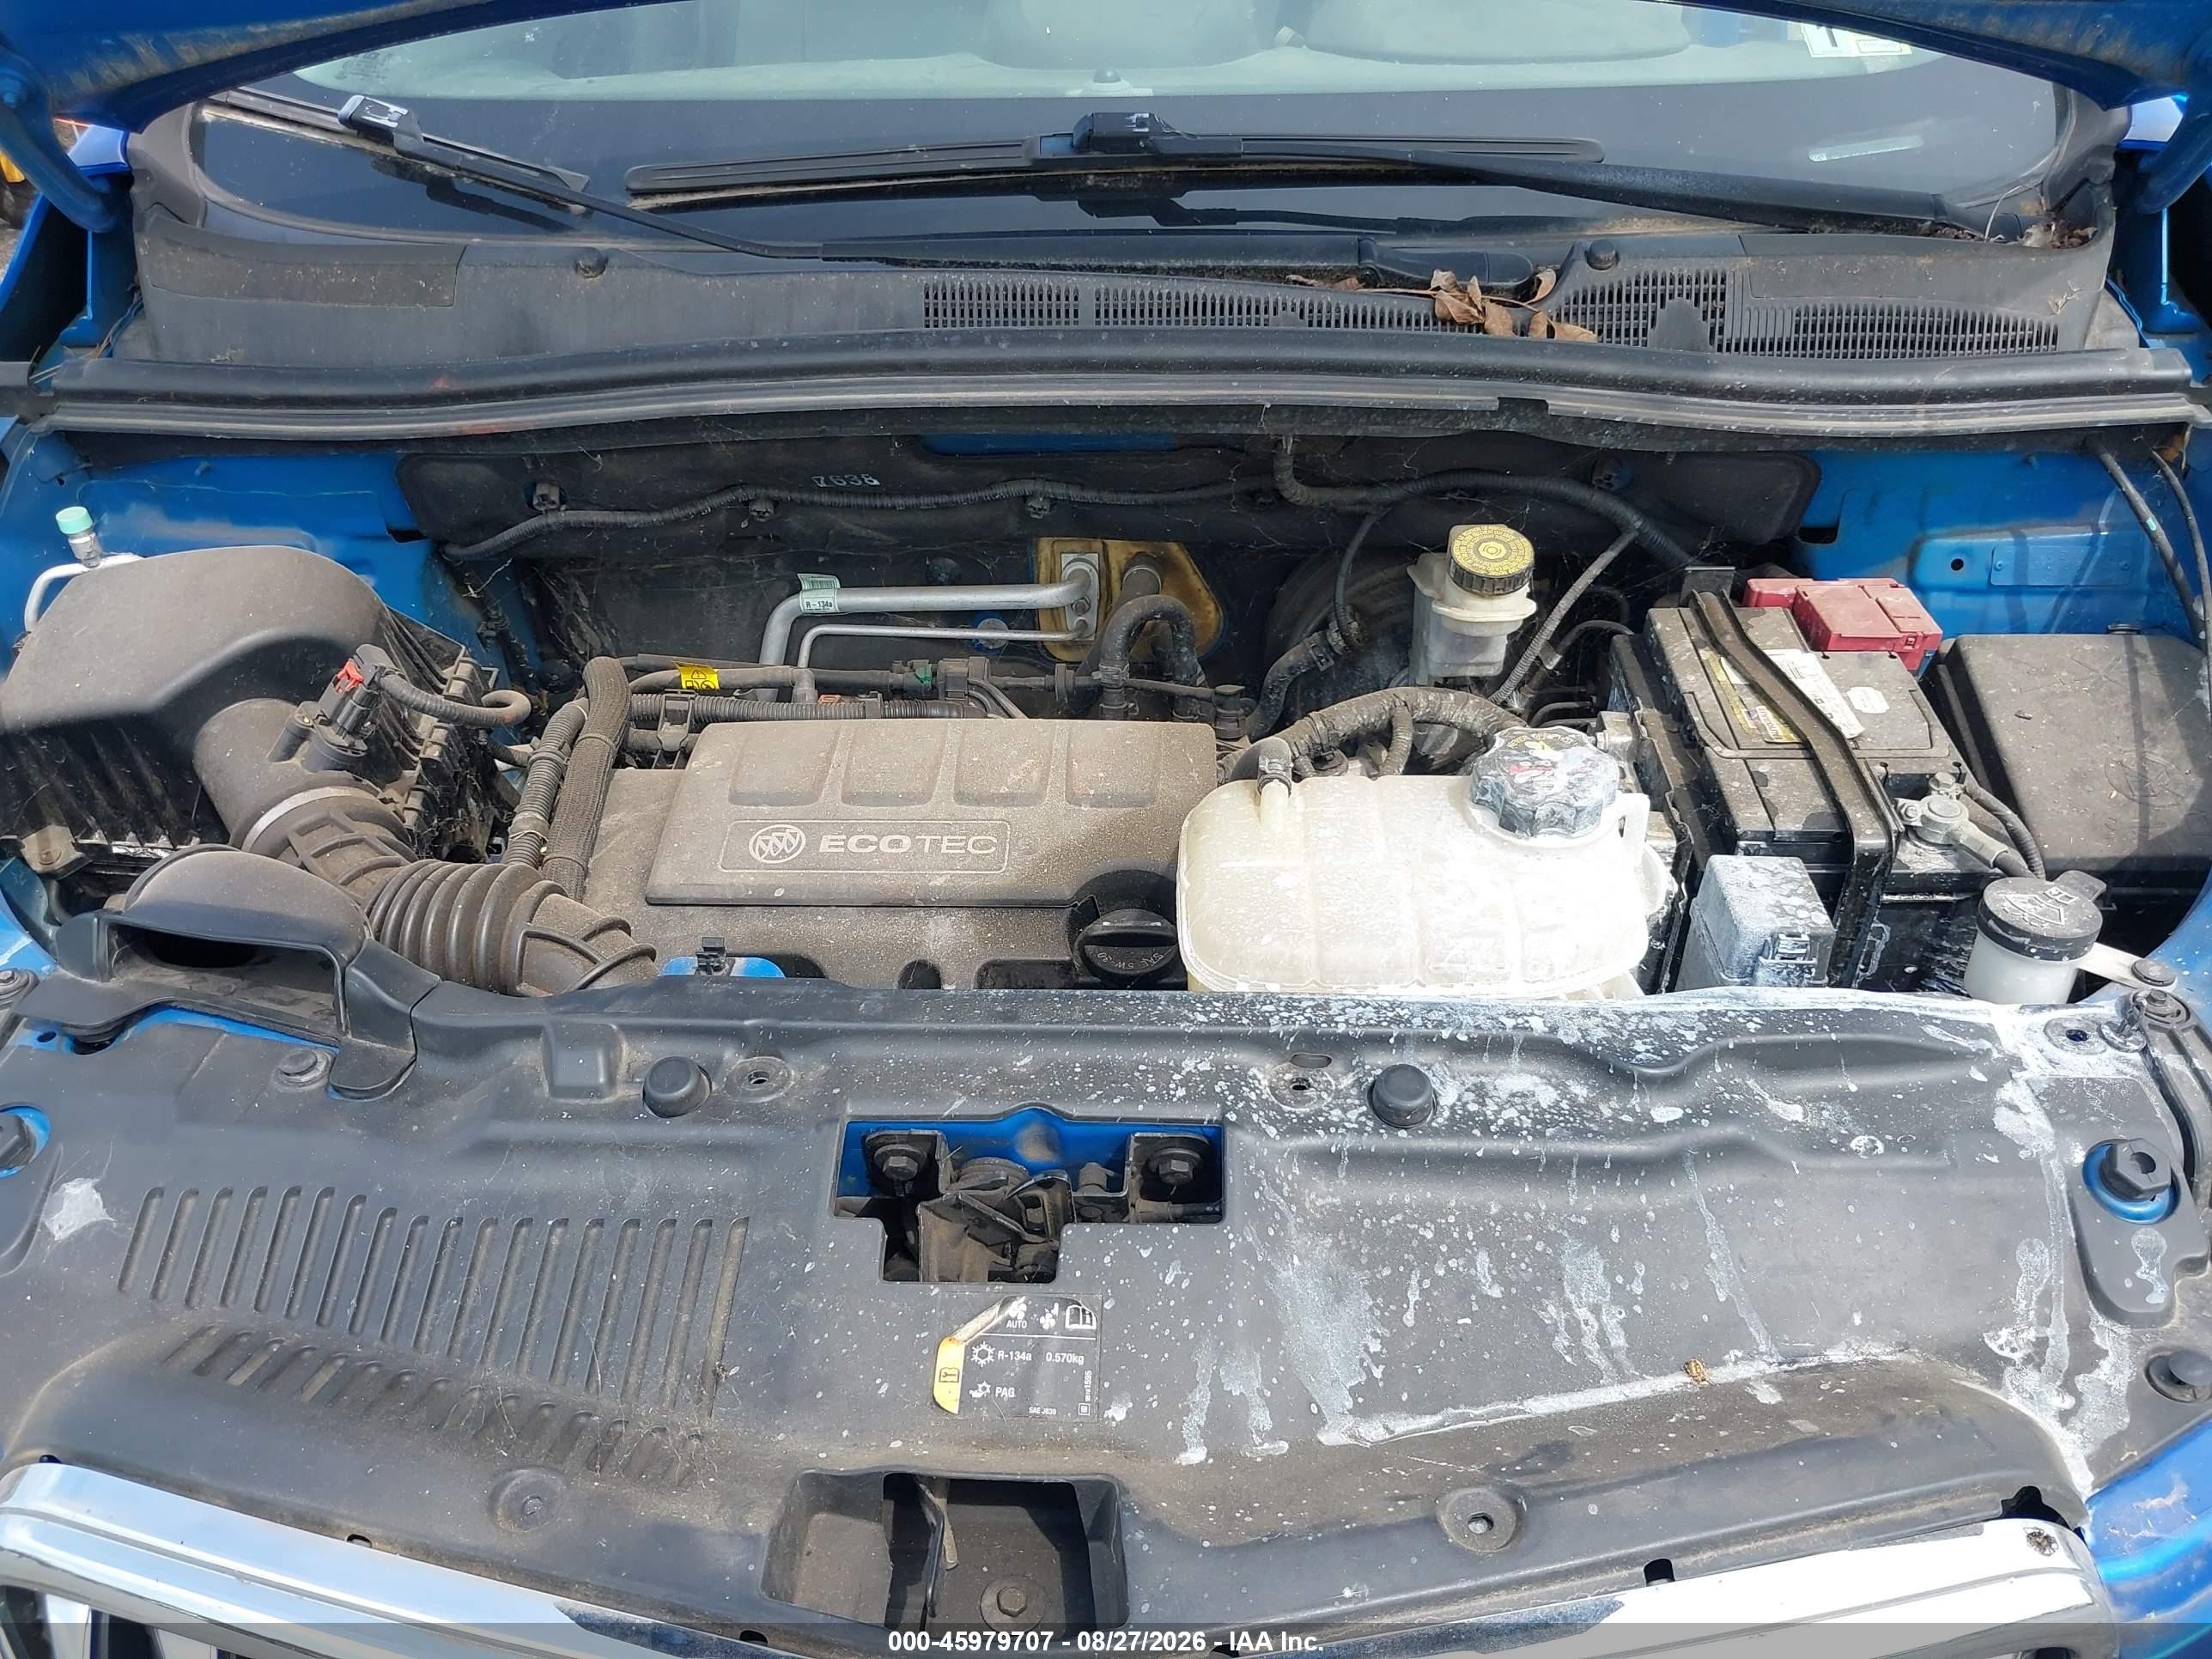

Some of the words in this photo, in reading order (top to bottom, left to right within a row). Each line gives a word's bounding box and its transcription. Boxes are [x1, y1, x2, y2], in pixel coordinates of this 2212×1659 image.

[819, 834, 998, 854] ECOTEC
[1006, 1319, 1028, 1329] AUTO
[997, 1350, 1032, 1362] R-134a
[1045, 1352, 1085, 1365] 0.570kg
[994, 1386, 1016, 1398] PAG
